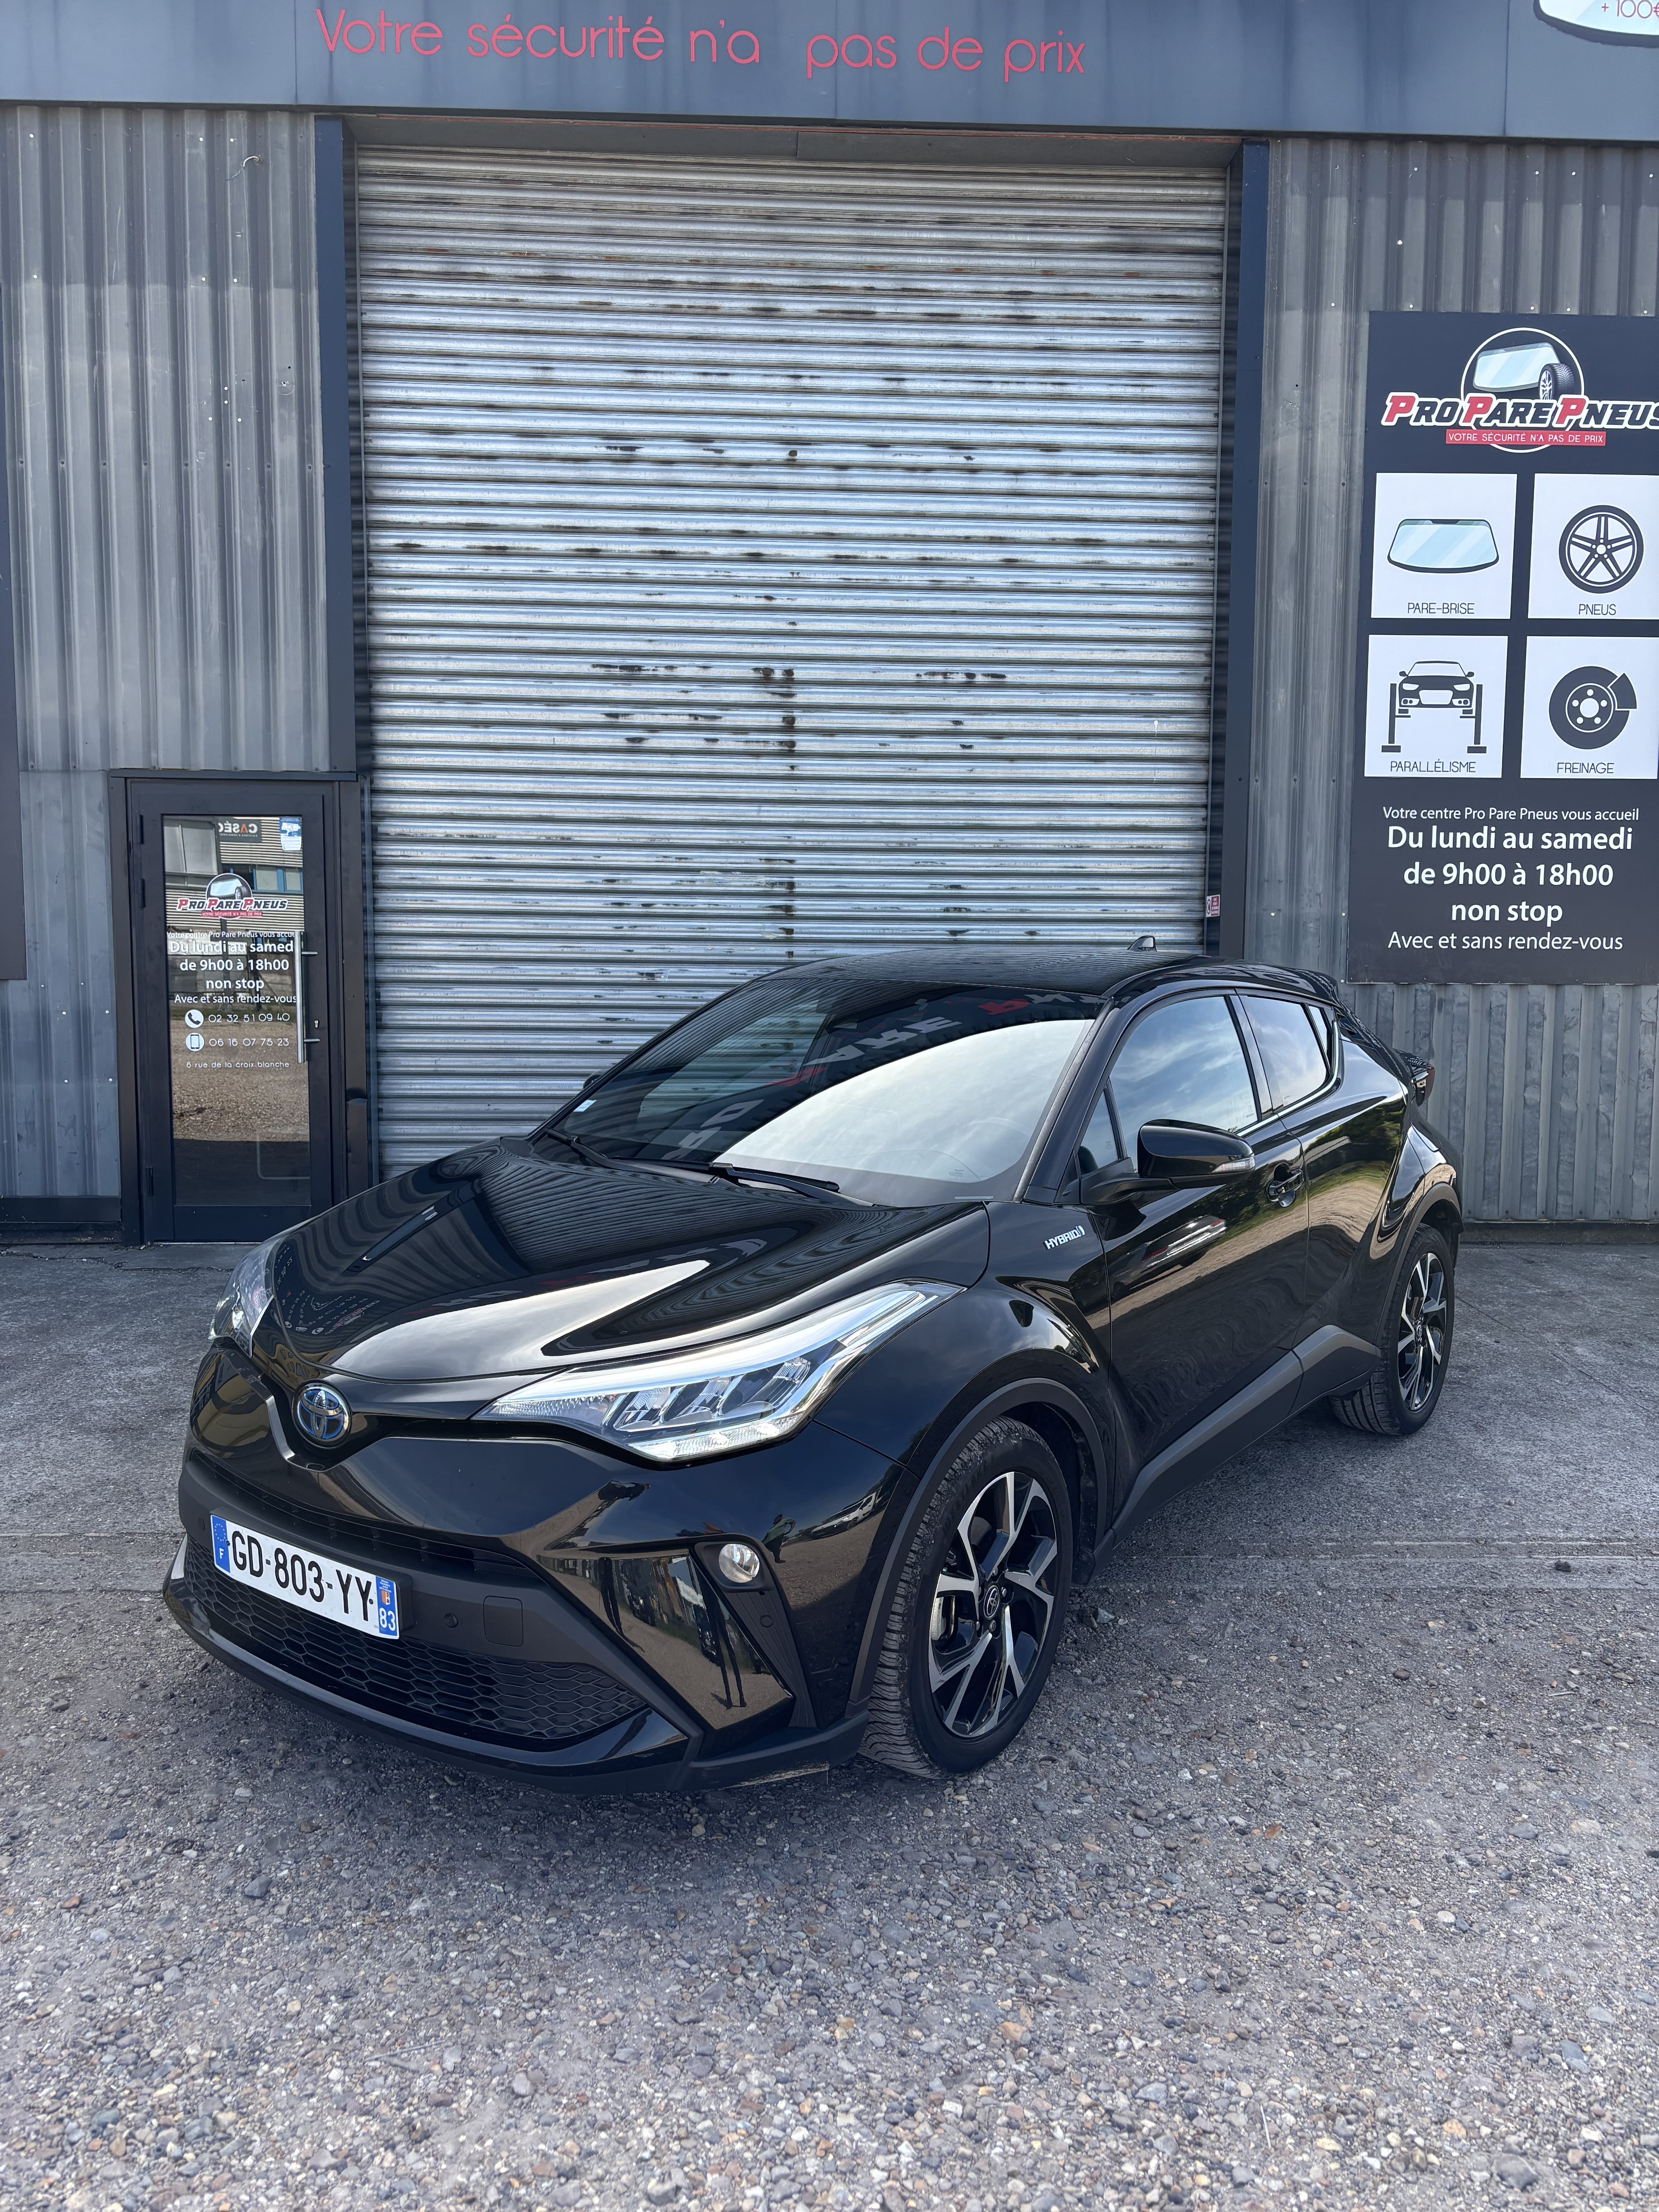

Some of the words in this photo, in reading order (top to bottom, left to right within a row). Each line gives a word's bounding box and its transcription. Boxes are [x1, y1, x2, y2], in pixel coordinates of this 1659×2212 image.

[315, 9, 443, 56] Votre
[467, 15, 665, 62] sécurité
[690, 21, 760, 65] n'a
[806, 34, 896, 78] pas
[918, 26, 983, 72] de
[1004, 30, 1085, 82] prix
[1382, 393, 1461, 424] PRO
[1462, 394, 1556, 426] PARE
[1449, 433, 1478, 441] VOTRE
[1482, 431, 1526, 442] SÉCURITÉ
[1530, 434, 1544, 442] N'A
[1549, 434, 1564, 442] PAS
[1568, 434, 1581, 443] DE
[1585, 435, 1604, 443] PRIX
[1407, 602, 1475, 615] PARE-BRISE
[1578, 604, 1616, 616] PNEUS
[1390, 759, 1476, 773] PARALLÉLISME
[1557, 762, 1614, 774] FREINAGE
[1383, 807, 1417, 819] Votre
[1420, 808, 1461, 820] centre
[1465, 808, 1486, 820] Pro
[1489, 808, 1517, 821] Pare
[1520, 809, 1558, 821] Pneus
[1561, 811, 1592, 821] vous
[1594, 808, 1640, 821] accueil
[1388, 826, 1424, 849] Du
[1431, 825, 1496, 850] lundi
[1503, 831, 1533, 850] au
[1541, 826, 1633, 850] samedi
[1403, 862, 1436, 885] de
[1443, 862, 1506, 886] 9h00
[1513, 863, 1527, 886] à
[1536, 864, 1614, 886] 18h00
[177, 898, 207, 911] PRO
[207, 898, 242, 911] PARE
[242, 898, 288, 911] PNEUS
[1451, 903, 1500, 922] non
[1508, 900, 1563, 927] stop
[170, 941, 189, 953] Du
[193, 941, 226, 953] lundi
[230, 943, 246, 953] au
[250, 940, 294, 953] samed
[1388, 932, 1433, 950] Avec
[1438, 933, 1457, 950] et
[1462, 935, 1503, 950] sans
[1508, 932, 1623, 951] rendez-vous
[180, 959, 196, 971] de
[200, 959, 233, 971] 9h00
[237, 959, 245, 970] à
[249, 959, 290, 971] 18h00
[206, 980, 232, 989] non
[235, 978, 264, 990] stop
[174, 994, 198, 1004] Avec
[201, 995, 210, 1003] et
[213, 995, 234, 1003] sans
[237, 994, 296, 1003] rendez-vous
[208, 1014, 222, 1023] 02
[227, 1014, 239, 1023] 32
[243, 1014, 255, 1023] 51
[258, 1013, 273, 1022] 09
[276, 1013, 290, 1022] 40
[209, 1038, 224, 1046] 06
[228, 1038, 238, 1046] 16
[243, 1038, 256, 1046] 07
[261, 1038, 273, 1046] 75
[277, 1038, 289, 1046] 23
[1044, 1226, 1081, 1250] HYBRID
[219, 1547, 224, 1559] F
[232, 1530, 372, 1622] GD-803-YY
[379, 1607, 396, 1632] 83
